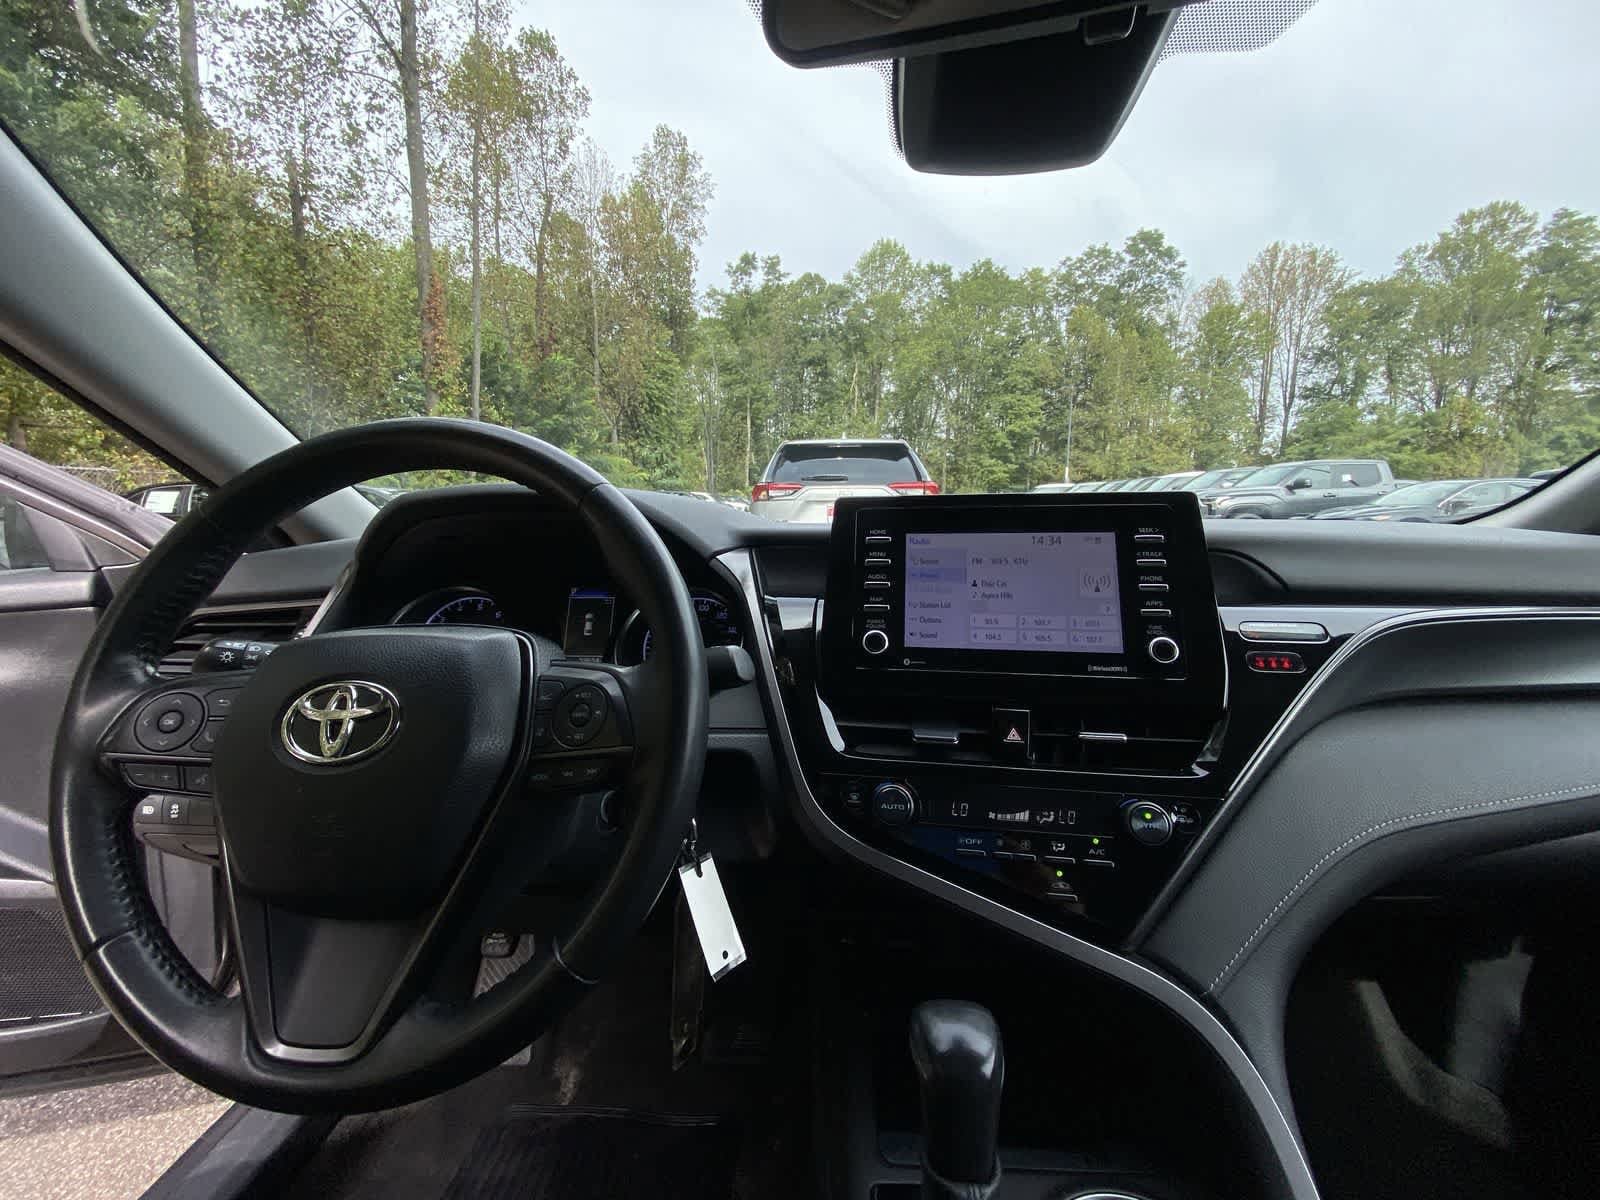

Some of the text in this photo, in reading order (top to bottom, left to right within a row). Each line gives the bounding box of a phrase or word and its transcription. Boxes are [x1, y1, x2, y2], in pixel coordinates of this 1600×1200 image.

[1031, 536, 1062, 546] 14:34
[1140, 575, 1163, 583] PHONE
[1145, 600, 1164, 608] APPS
[880, 802, 905, 811] AUTO
[1088, 847, 1105, 856] A/C
